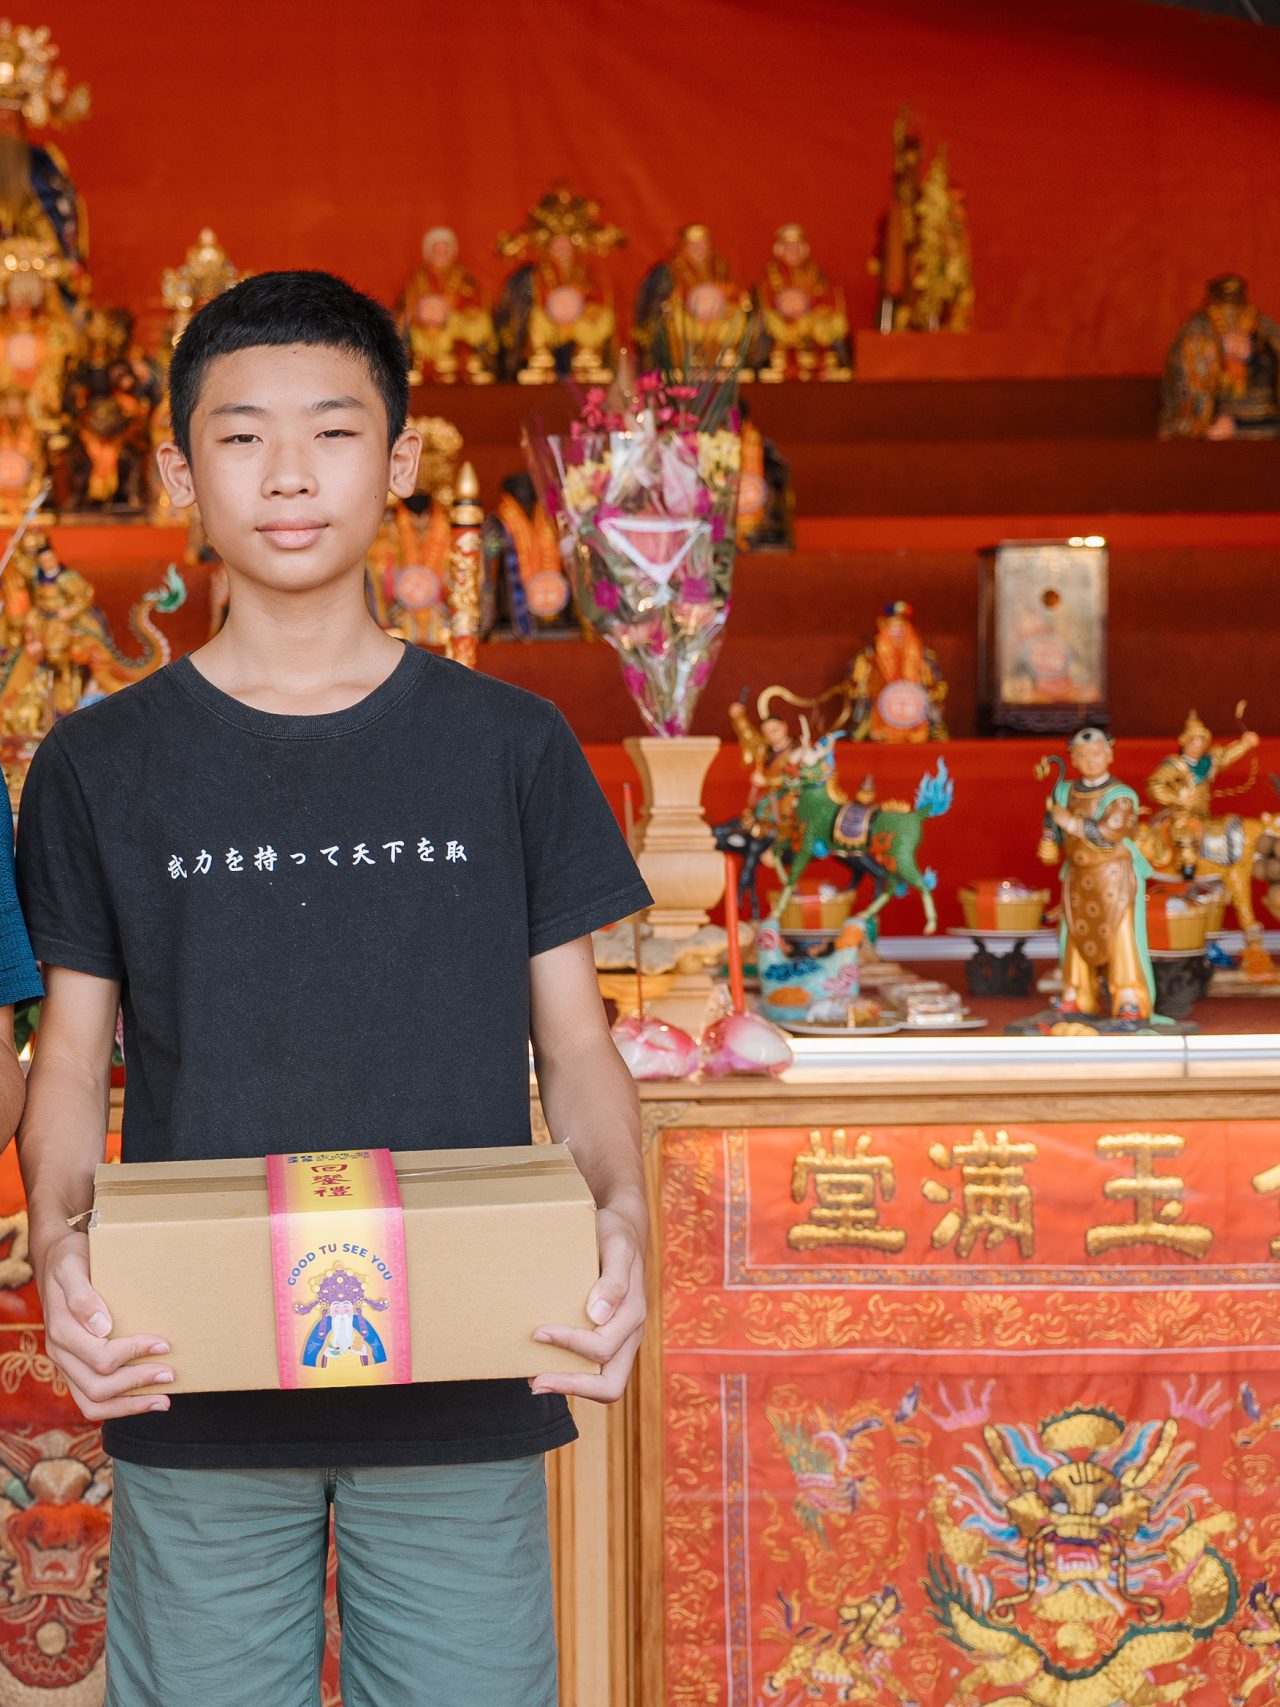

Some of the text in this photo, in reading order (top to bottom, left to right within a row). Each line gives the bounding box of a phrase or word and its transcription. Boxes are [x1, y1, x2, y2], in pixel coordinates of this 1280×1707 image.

[287, 1243, 393, 1286] GOOD TU SEE YOU
